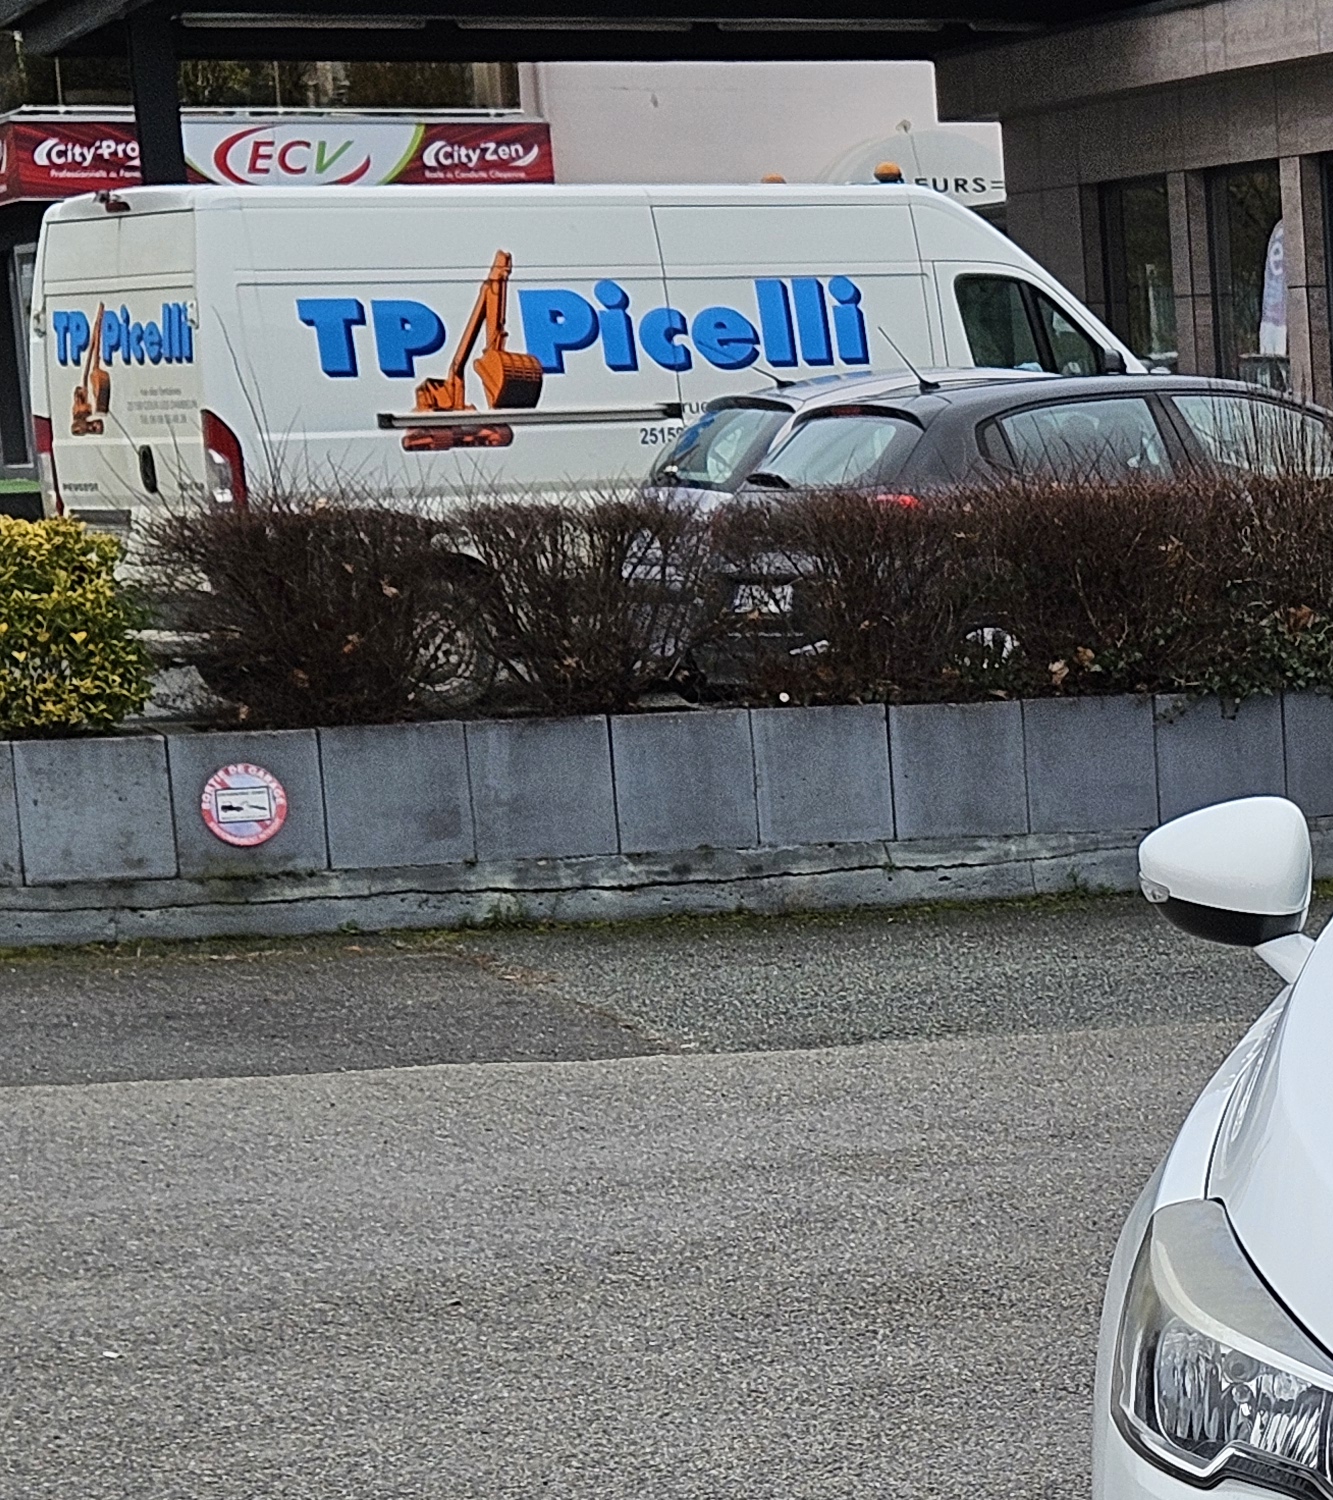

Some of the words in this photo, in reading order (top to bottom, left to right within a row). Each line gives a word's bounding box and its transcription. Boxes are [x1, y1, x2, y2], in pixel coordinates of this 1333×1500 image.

[247, 139, 354, 175] ECV
[53, 310, 91, 366] TP
[102, 303, 193, 366] Picelli
[295, 298, 445, 378] TP
[517, 274, 871, 374] Picelli
